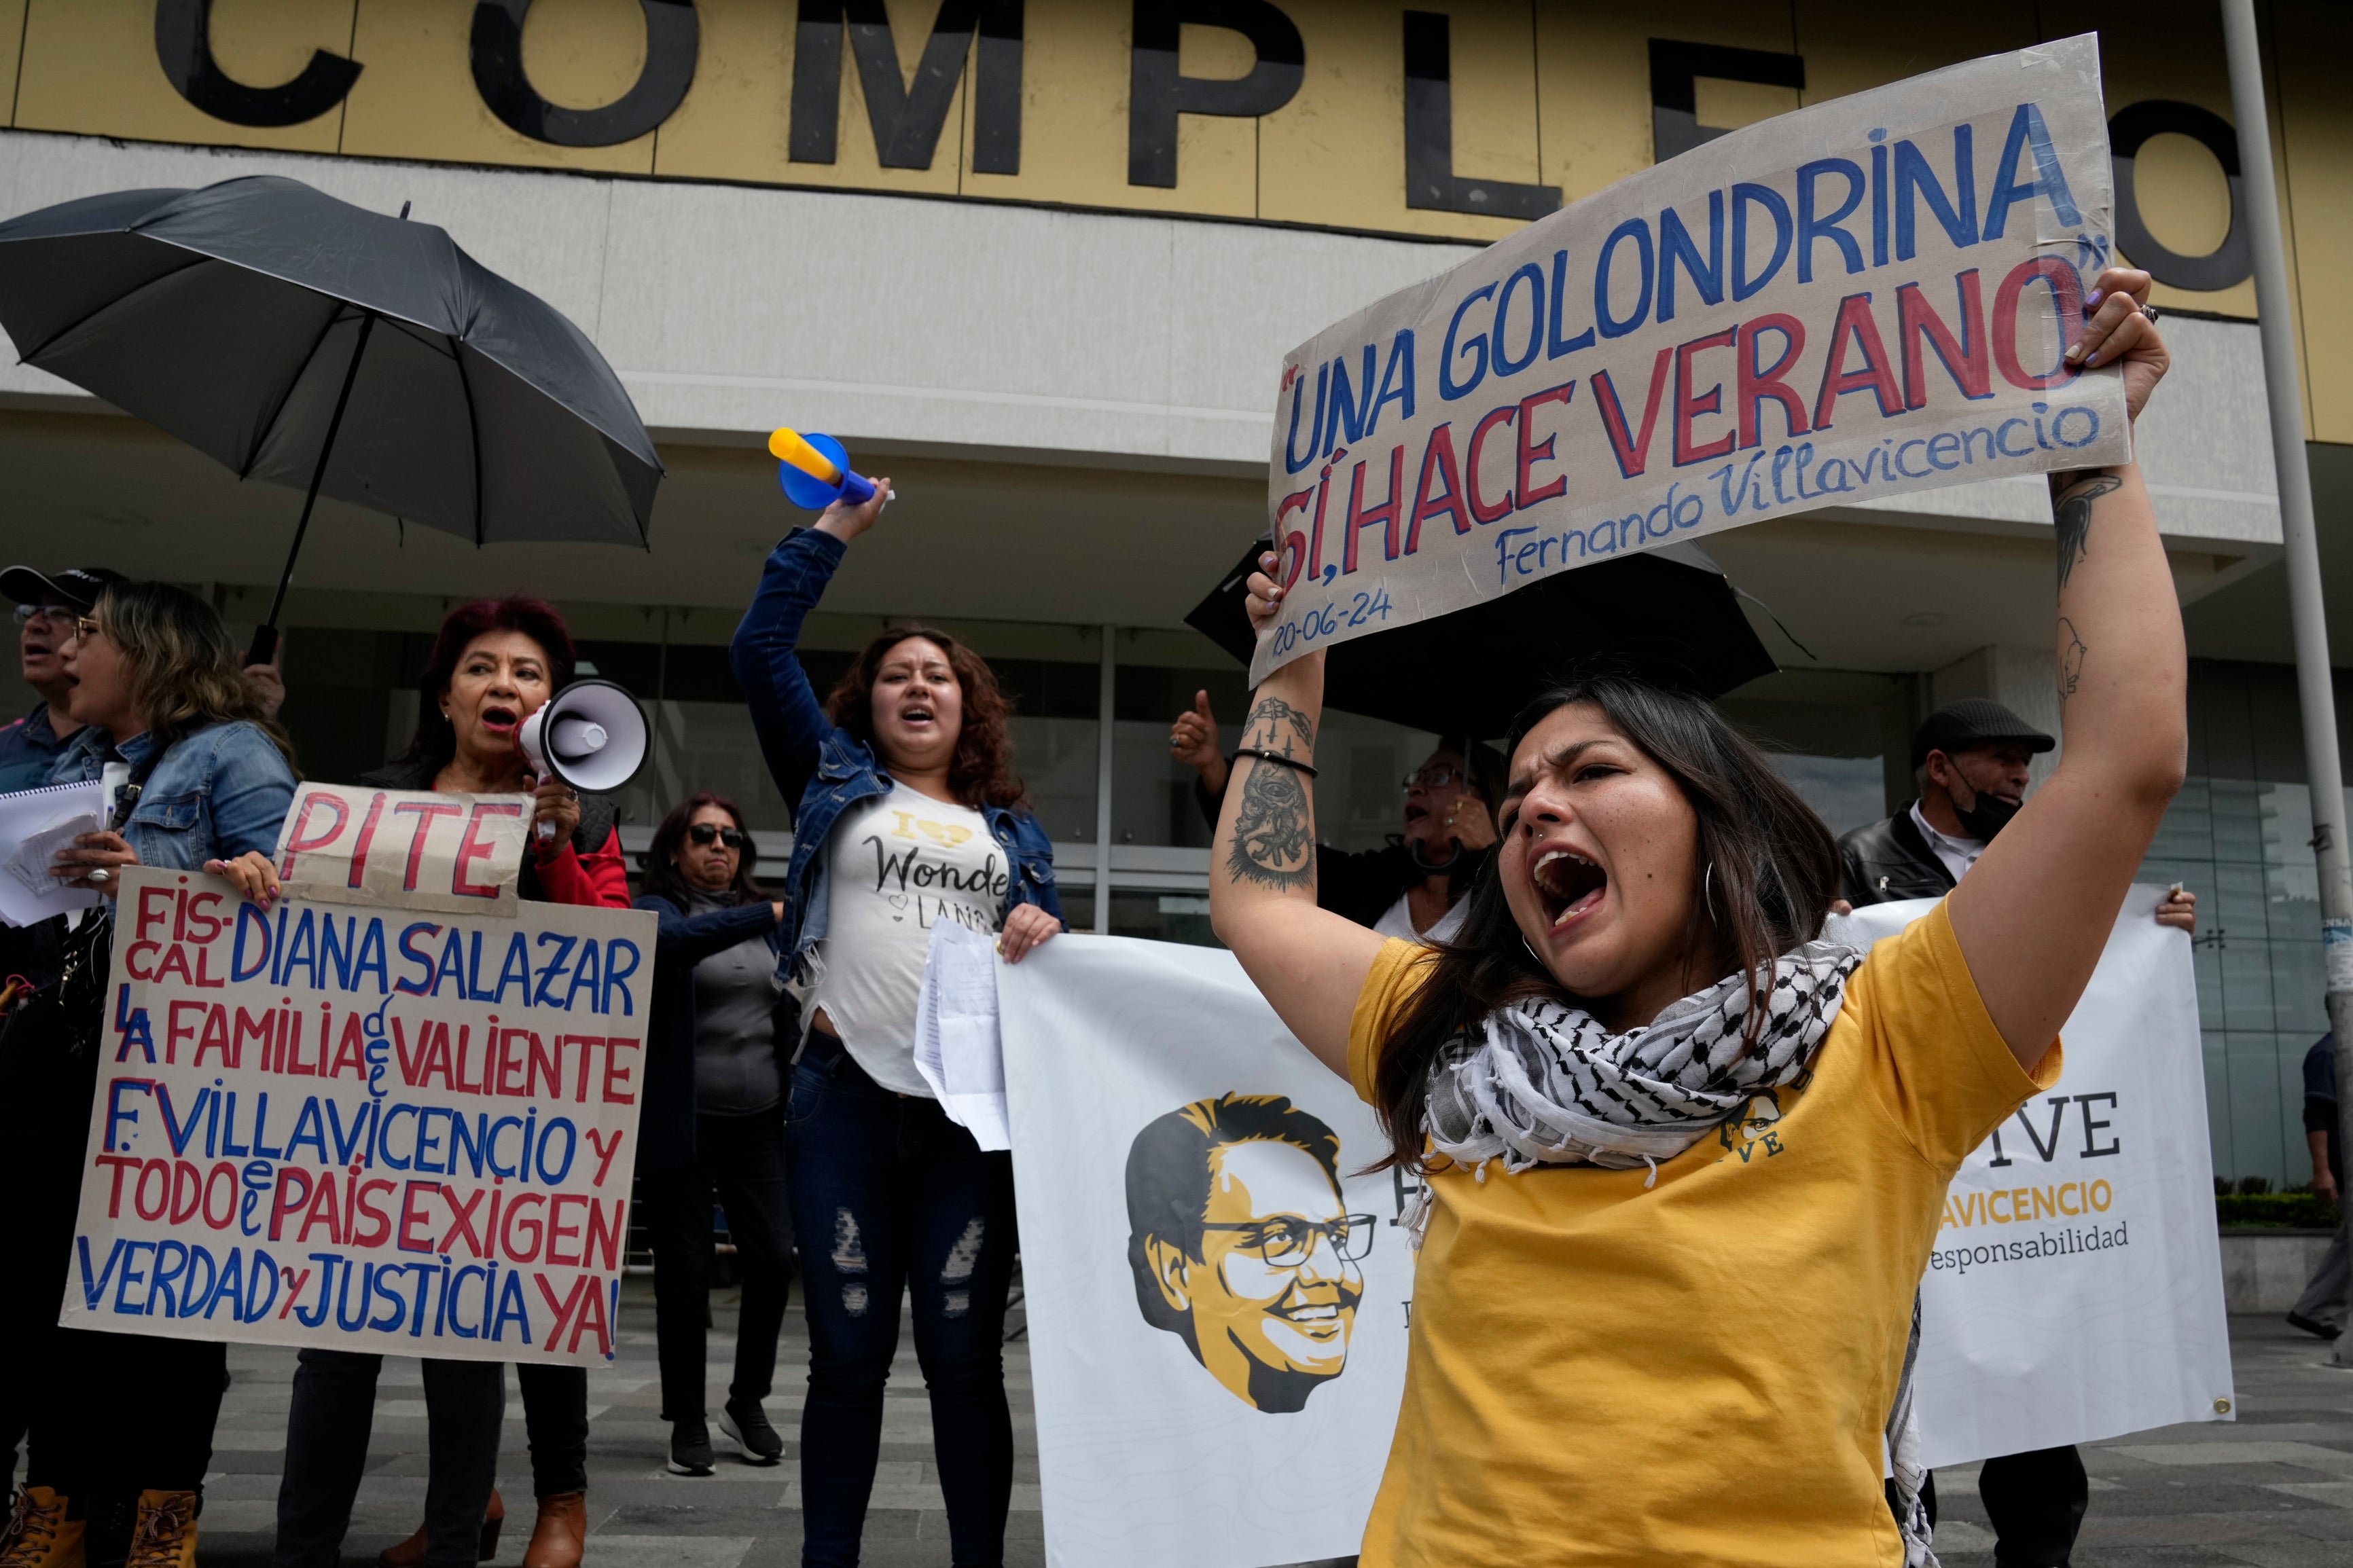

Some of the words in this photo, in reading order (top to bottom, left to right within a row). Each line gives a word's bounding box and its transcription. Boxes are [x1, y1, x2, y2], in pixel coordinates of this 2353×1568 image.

[1439, 103, 2083, 401] GOLONDRINA
[1342, 380, 1577, 575] HACE
[1494, 482, 1704, 585] Fernando
[1708, 401, 2100, 517] Villavicencio
[1272, 587, 1392, 657] 20-06-24
[279, 791, 523, 899] PITE
[125, 940, 225, 987] CAL
[136, 875, 233, 945] FIS-
[231, 898, 389, 994] DIANA
[393, 922, 641, 1017] SALAZAR
[114, 983, 157, 1063] LA
[166, 996, 368, 1081] FAMILIA
[390, 1015, 641, 1106] VALIENTE
[153, 1078, 577, 1186] VILLAVICENCIO
[1958, 1091, 2120, 1171] IVE
[95, 1154, 238, 1230] TODO
[268, 1153, 397, 1248] PAÍS
[397, 1175, 624, 1271] EXIGEN
[1928, 1220, 2129, 1275] esponsabilidad
[76, 1235, 280, 1324] VERDAD
[293, 1253, 533, 1345] JUSTICIA
[533, 1273, 619, 1361] YA!
